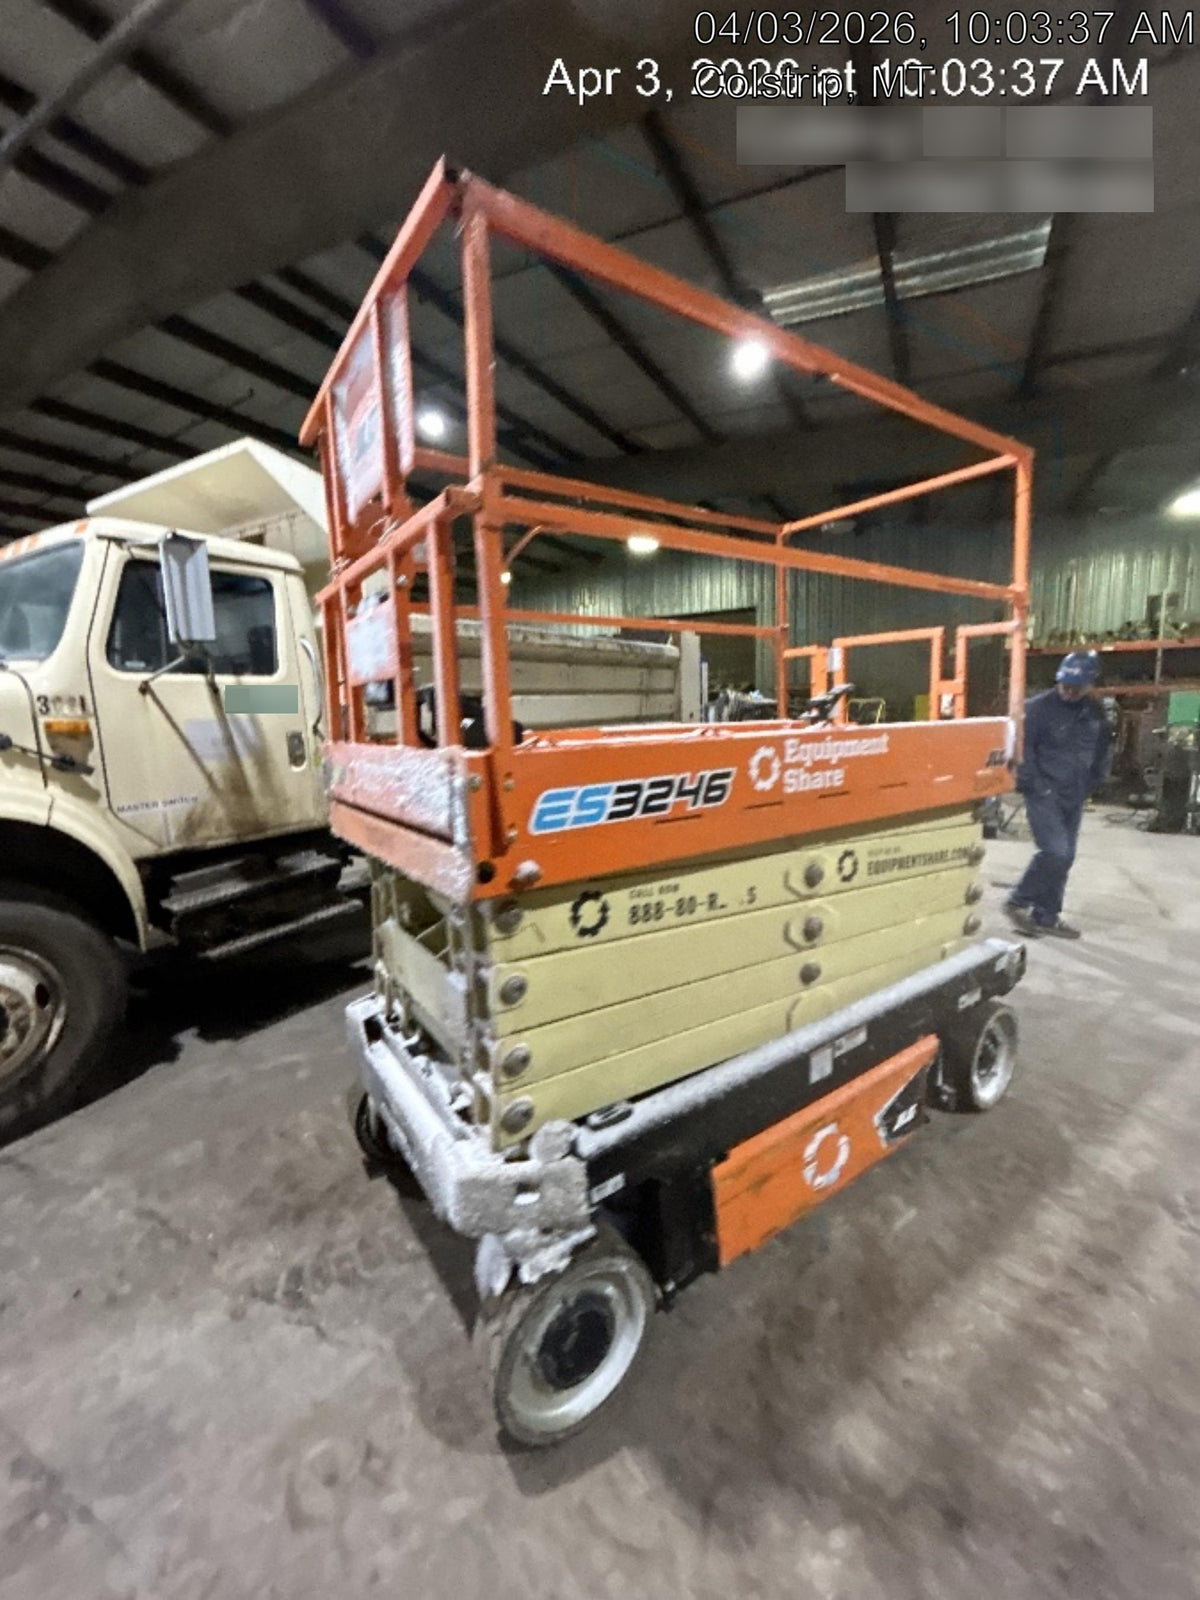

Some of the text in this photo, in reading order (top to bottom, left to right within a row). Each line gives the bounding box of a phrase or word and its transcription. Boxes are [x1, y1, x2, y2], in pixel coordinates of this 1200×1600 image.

[783, 733, 890, 767] Equipment
[783, 767, 846, 793] Share
[528, 767, 737, 835] ES3246
